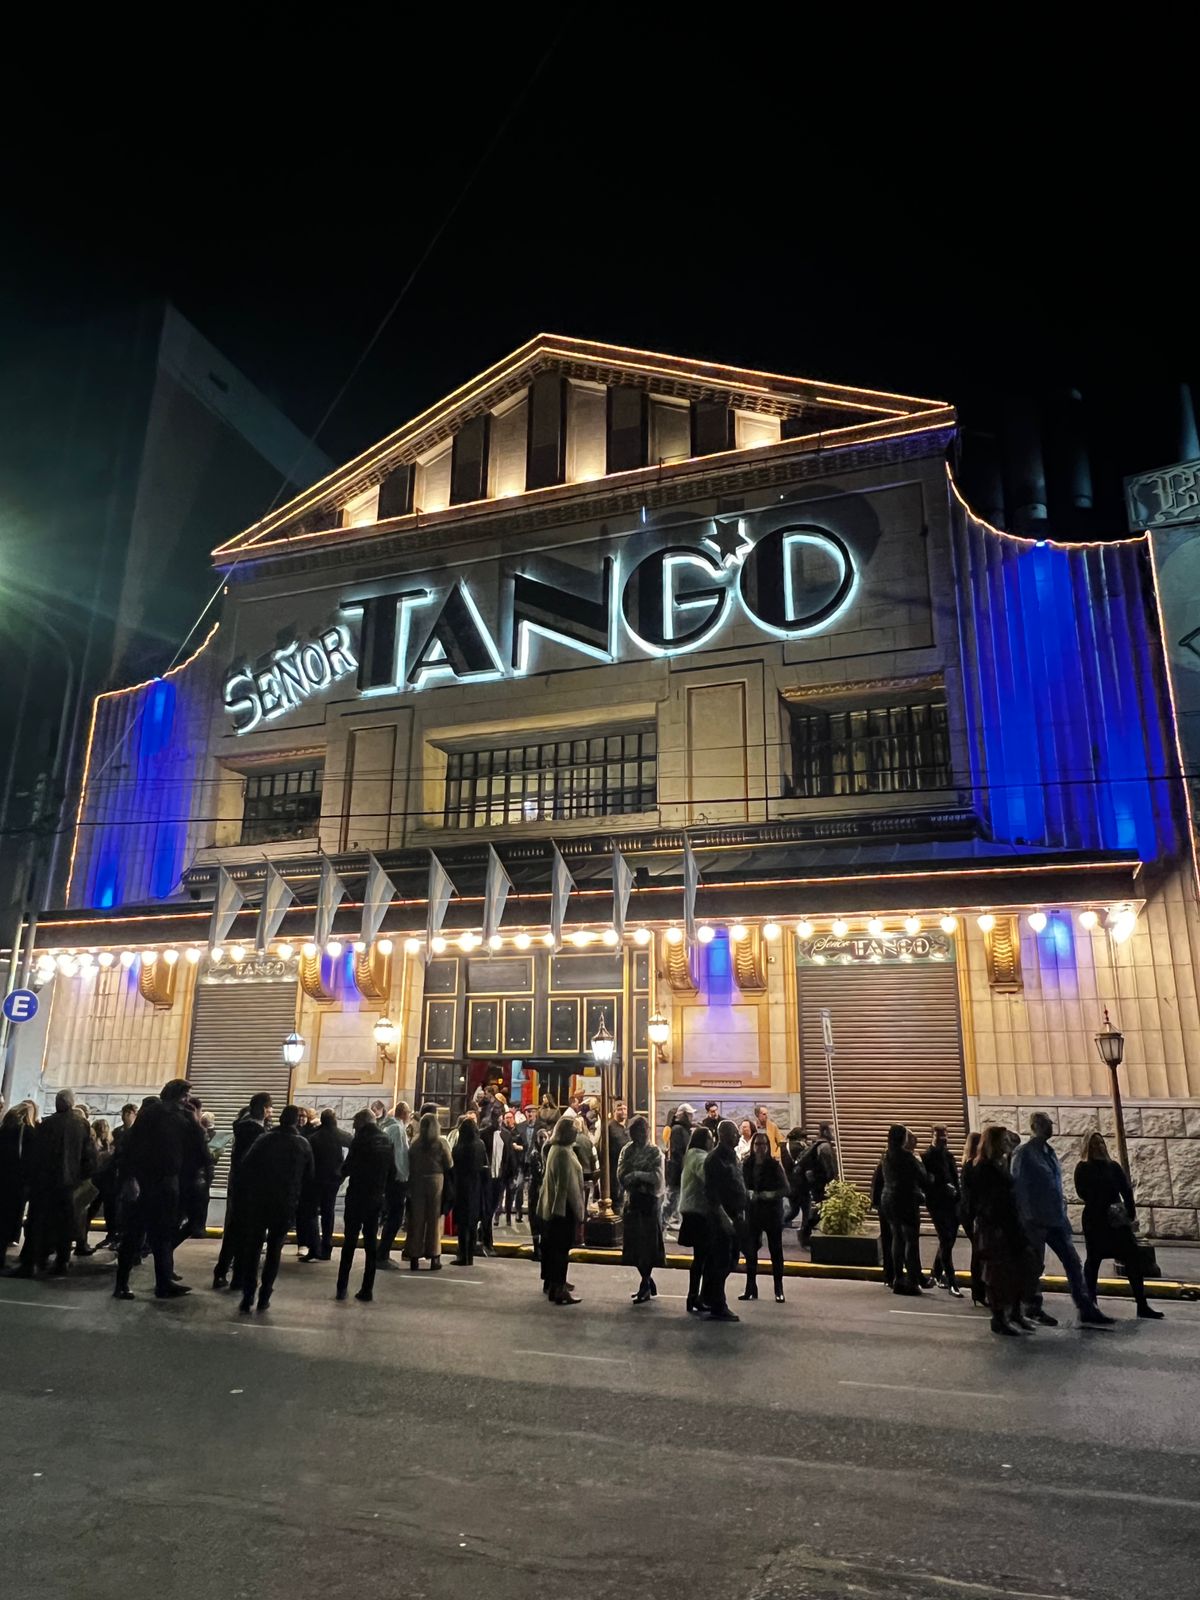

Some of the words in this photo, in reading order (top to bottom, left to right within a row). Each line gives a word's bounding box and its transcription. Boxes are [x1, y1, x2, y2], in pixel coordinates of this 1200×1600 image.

[222, 625, 359, 737] SEÑOR
[340, 523, 860, 697] TANGO
[852, 938, 930, 956] TANGO
[235, 961, 285, 976] TANGO
[12, 995, 30, 1016] E
